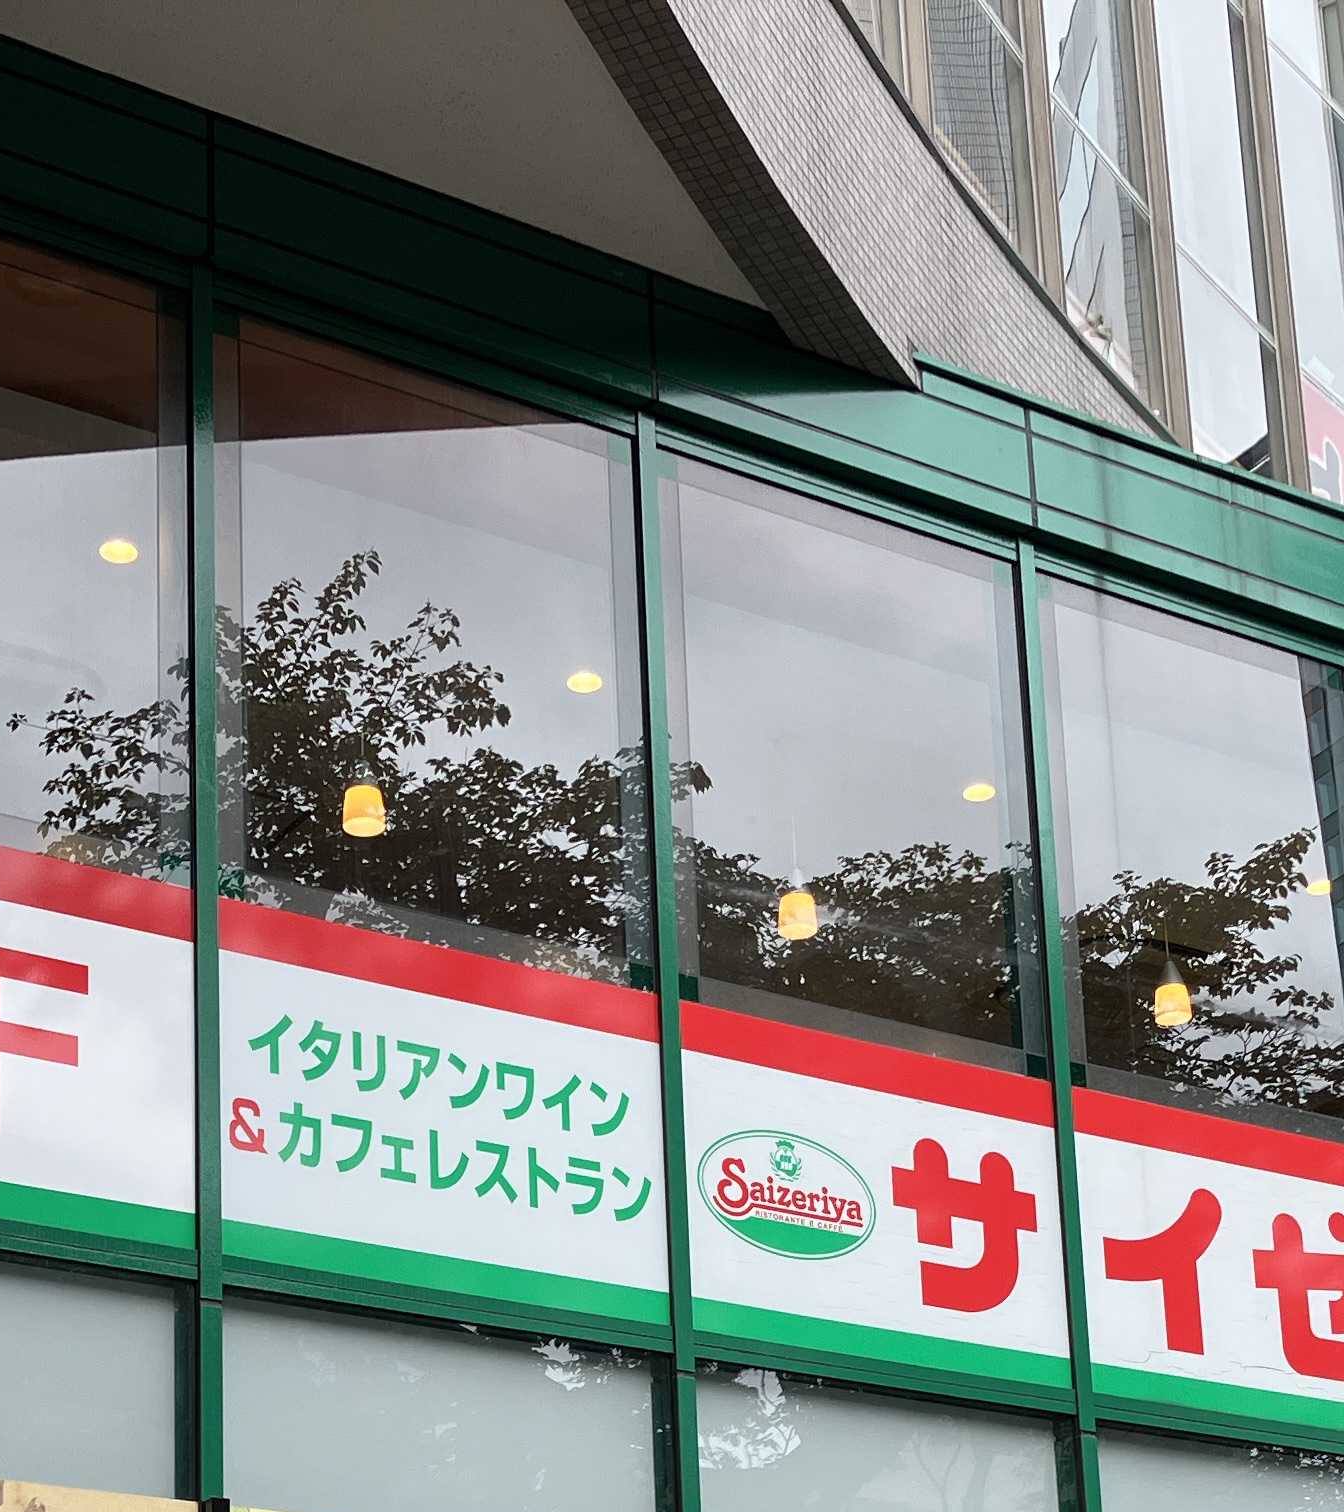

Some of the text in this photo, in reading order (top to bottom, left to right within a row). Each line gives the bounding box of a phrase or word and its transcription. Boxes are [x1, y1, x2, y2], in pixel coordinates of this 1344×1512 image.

[248, 1013, 630, 1137] イタリアンワイン
[715, 1157, 864, 1225] Saizeriya
[755, 1209, 806, 1226] RISTORANTE
